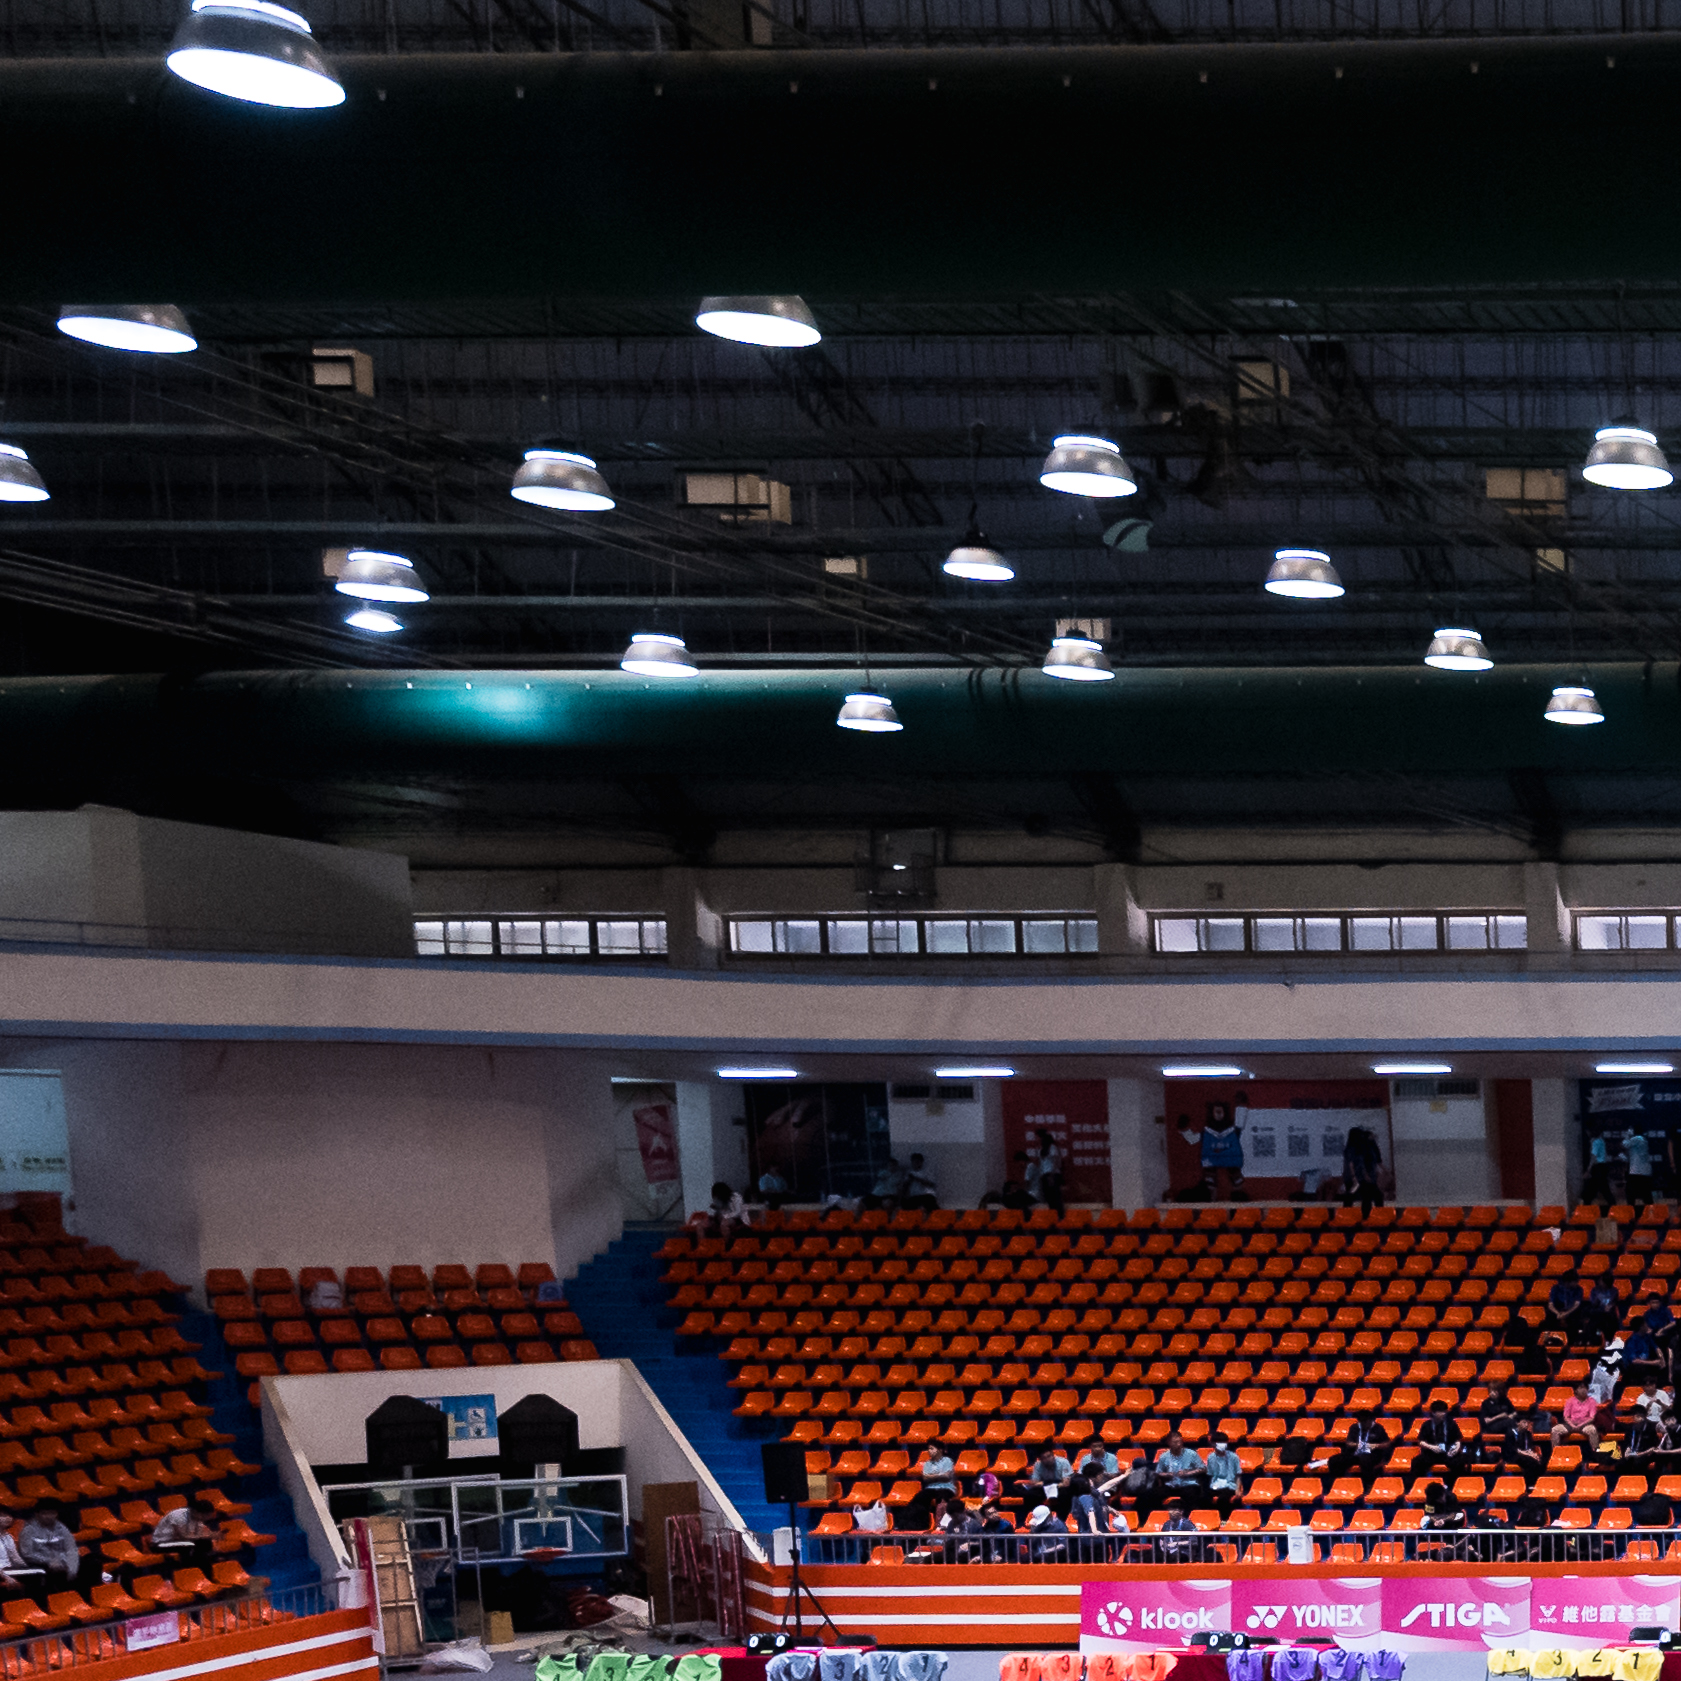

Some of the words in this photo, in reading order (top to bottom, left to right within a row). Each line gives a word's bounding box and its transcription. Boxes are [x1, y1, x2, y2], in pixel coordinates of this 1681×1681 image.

[1141, 1607, 1214, 1629] klook
[1292, 1604, 1364, 1628] YONEX
[1401, 1602, 1511, 1628] STIGA
[1019, 1658, 1029, 1675] 4
[1062, 1655, 1070, 1672] 3
[1553, 1649, 1563, 1666] 3
[1632, 1652, 1640, 1670] 1
[1106, 1658, 1114, 1676] 2
